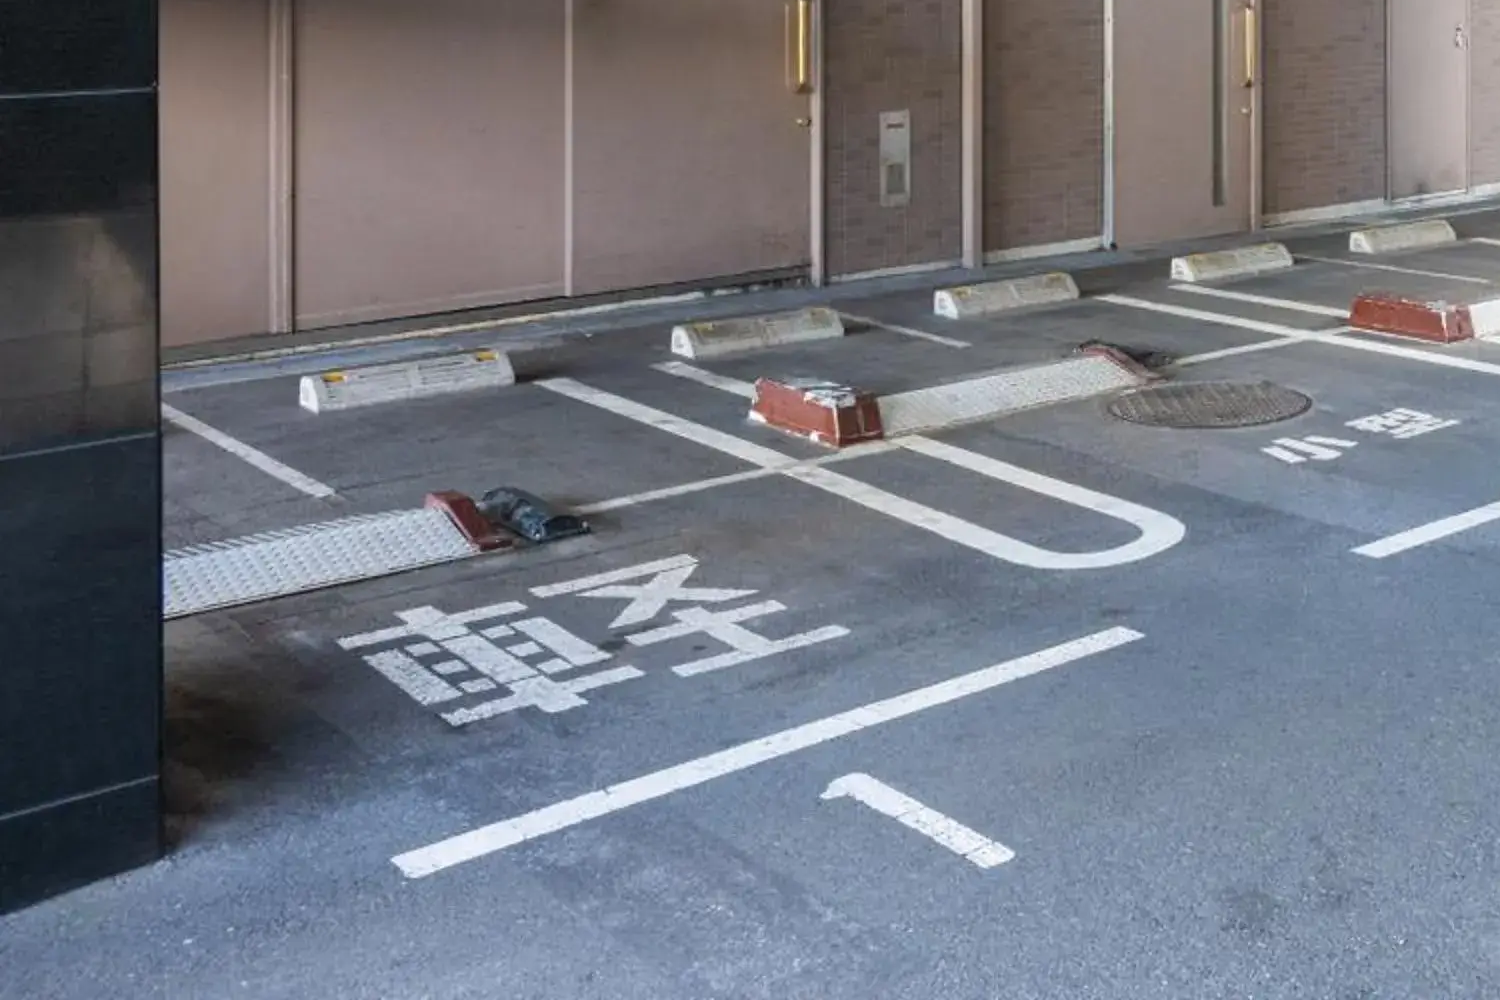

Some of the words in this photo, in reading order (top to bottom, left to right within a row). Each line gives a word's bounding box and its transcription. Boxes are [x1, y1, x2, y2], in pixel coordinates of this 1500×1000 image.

[1262, 406, 1460, 465] 小型
[336, 553, 851, 727] 軽
[819, 772, 1017, 870] 1
